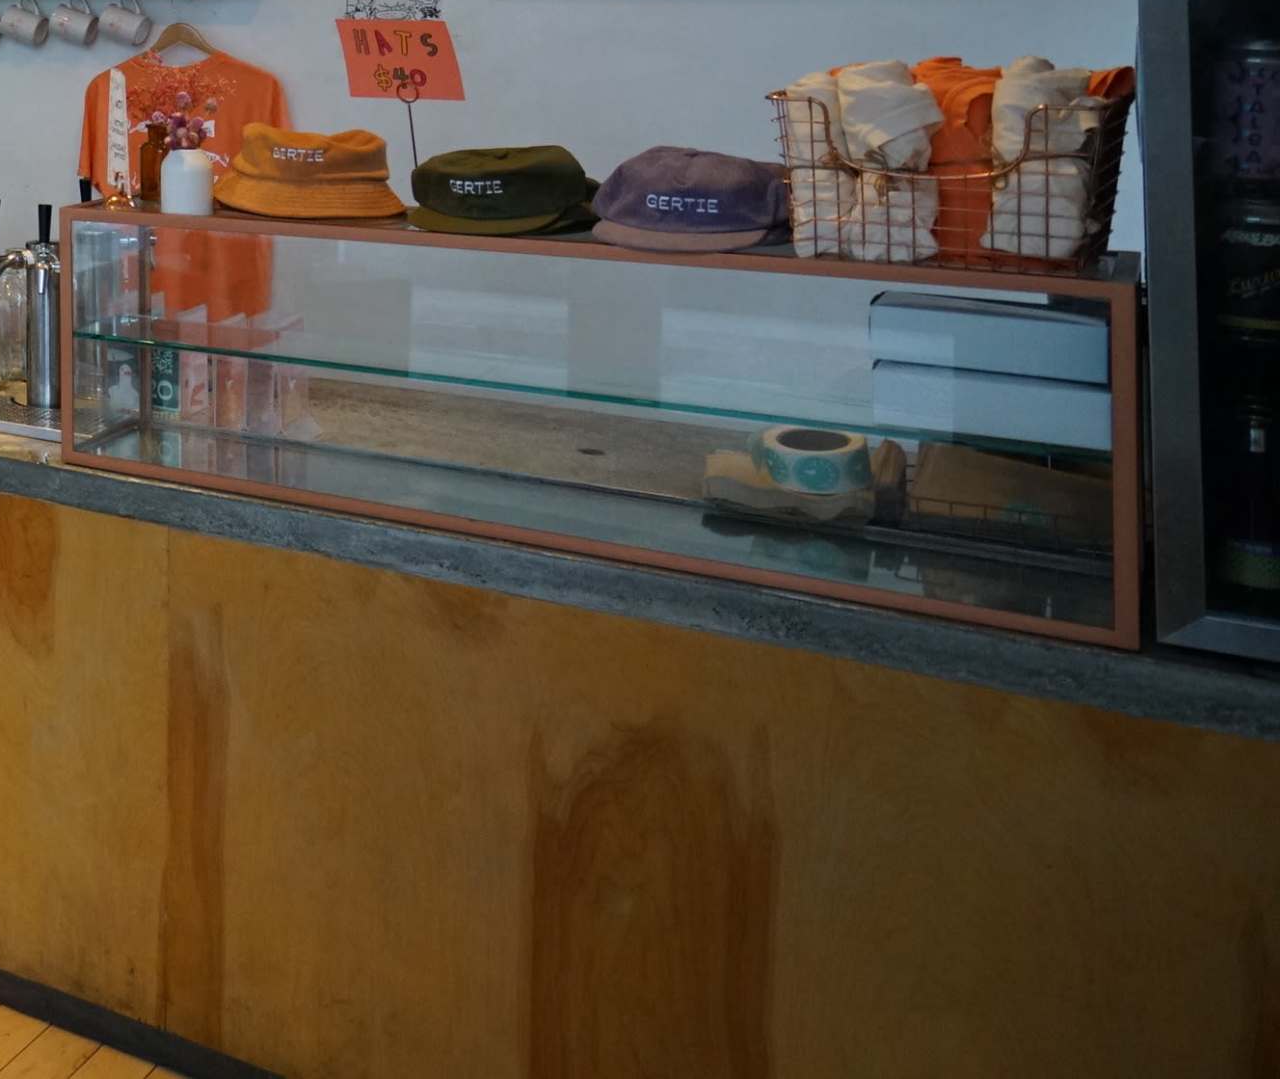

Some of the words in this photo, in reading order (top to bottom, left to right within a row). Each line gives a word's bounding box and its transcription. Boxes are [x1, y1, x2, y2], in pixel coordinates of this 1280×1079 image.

[353, 28, 439, 58] HATS
[373, 64, 427, 92] $40
[272, 147, 324, 162] GERTIE
[449, 178, 504, 195] GERTIE
[646, 193, 719, 214] GERTIE
